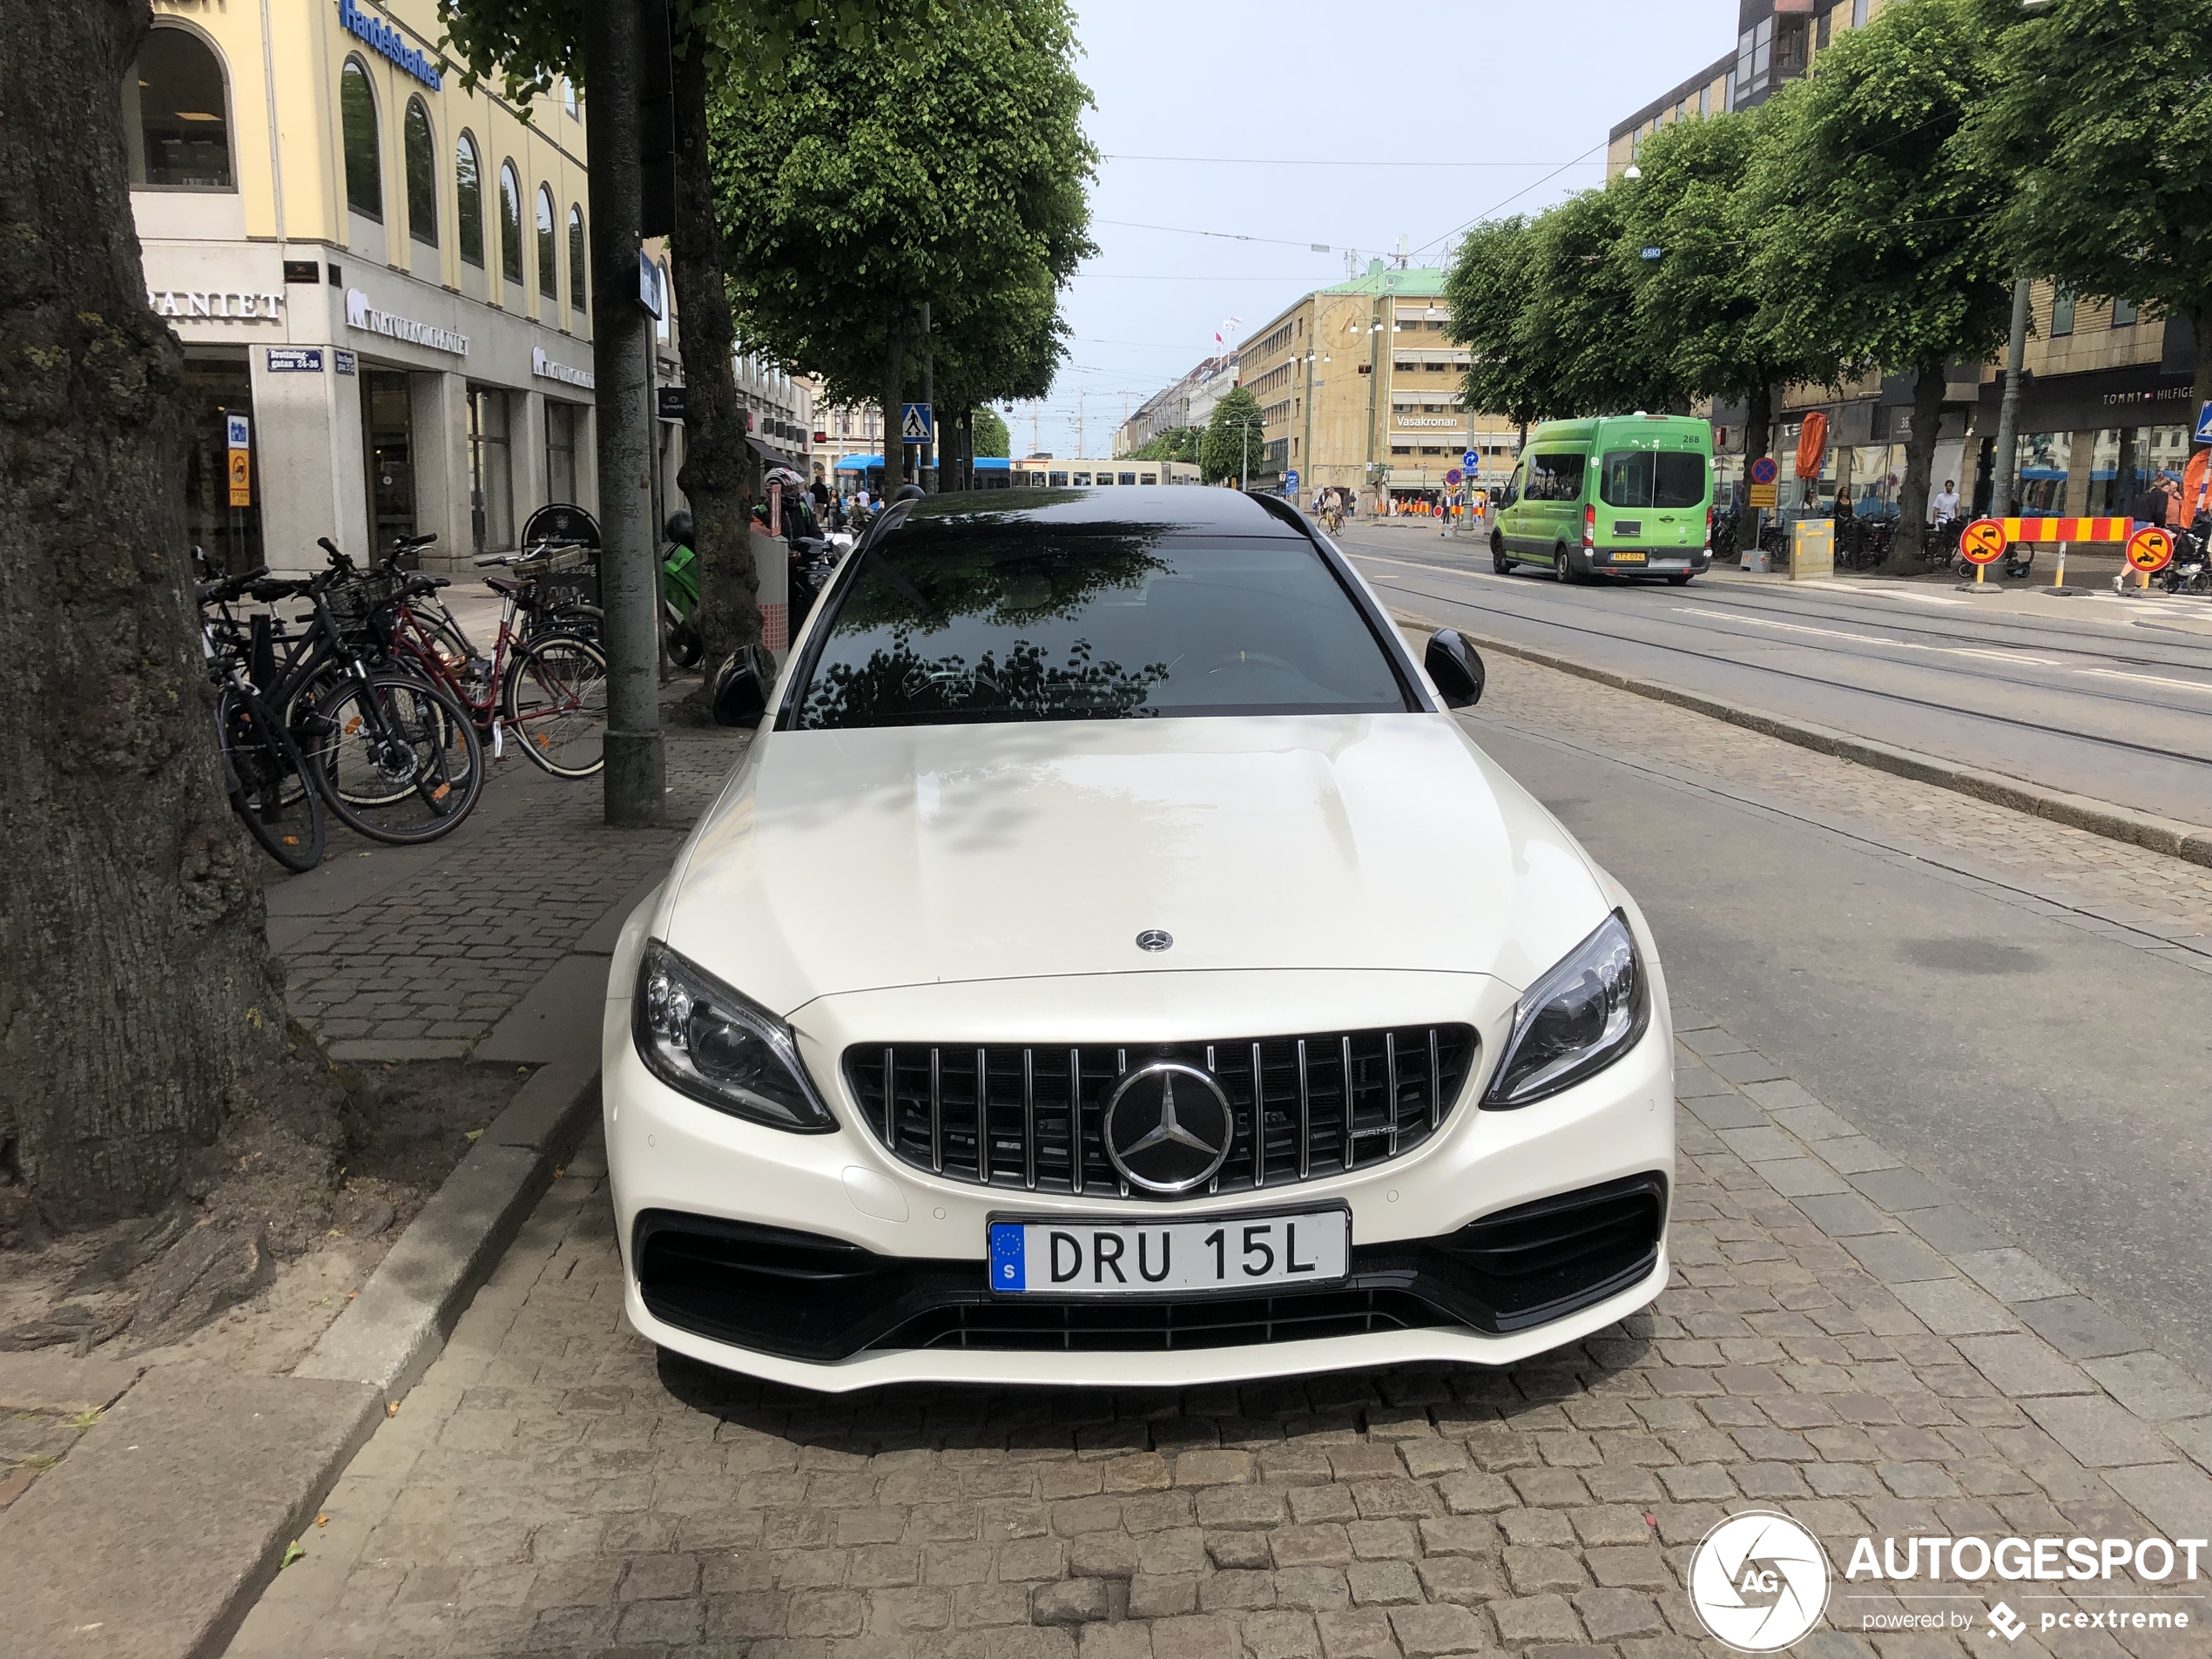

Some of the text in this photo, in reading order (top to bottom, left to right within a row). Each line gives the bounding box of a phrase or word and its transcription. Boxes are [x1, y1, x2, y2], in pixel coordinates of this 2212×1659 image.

[340, 0, 441, 91] Handelsbanken
[1642, 248, 1661, 258] 6510
[370, 309, 470, 356] NATURKOMPANIET
[2103, 391, 2141, 405] TOMMY
[1397, 415, 1458, 428] Vasakronan
[1050, 1222, 1317, 1283] DRU 15L
[1003, 1264, 1015, 1278] S
